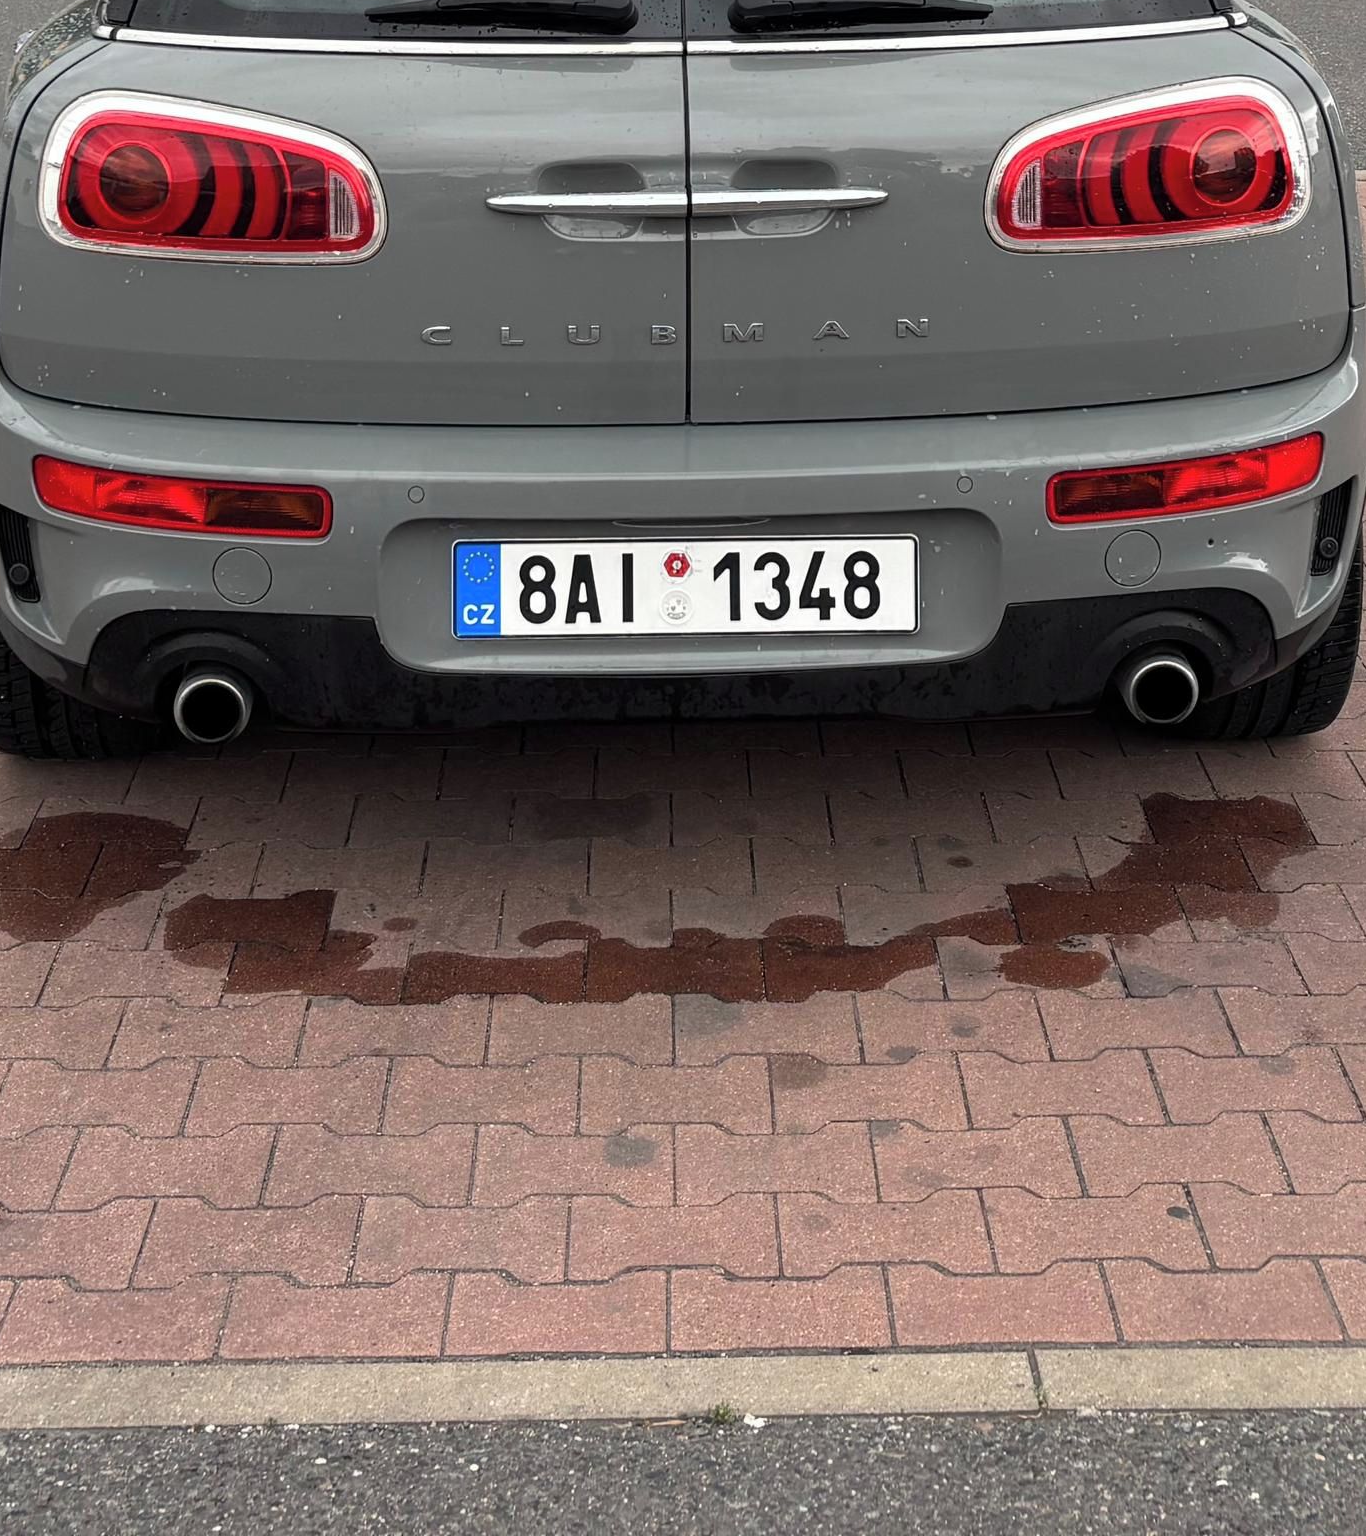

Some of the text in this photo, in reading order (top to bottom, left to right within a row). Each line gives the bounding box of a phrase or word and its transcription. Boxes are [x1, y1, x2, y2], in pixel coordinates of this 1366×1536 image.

[518, 550, 881, 625] 8AI 1348
[462, 603, 496, 626] CZ
